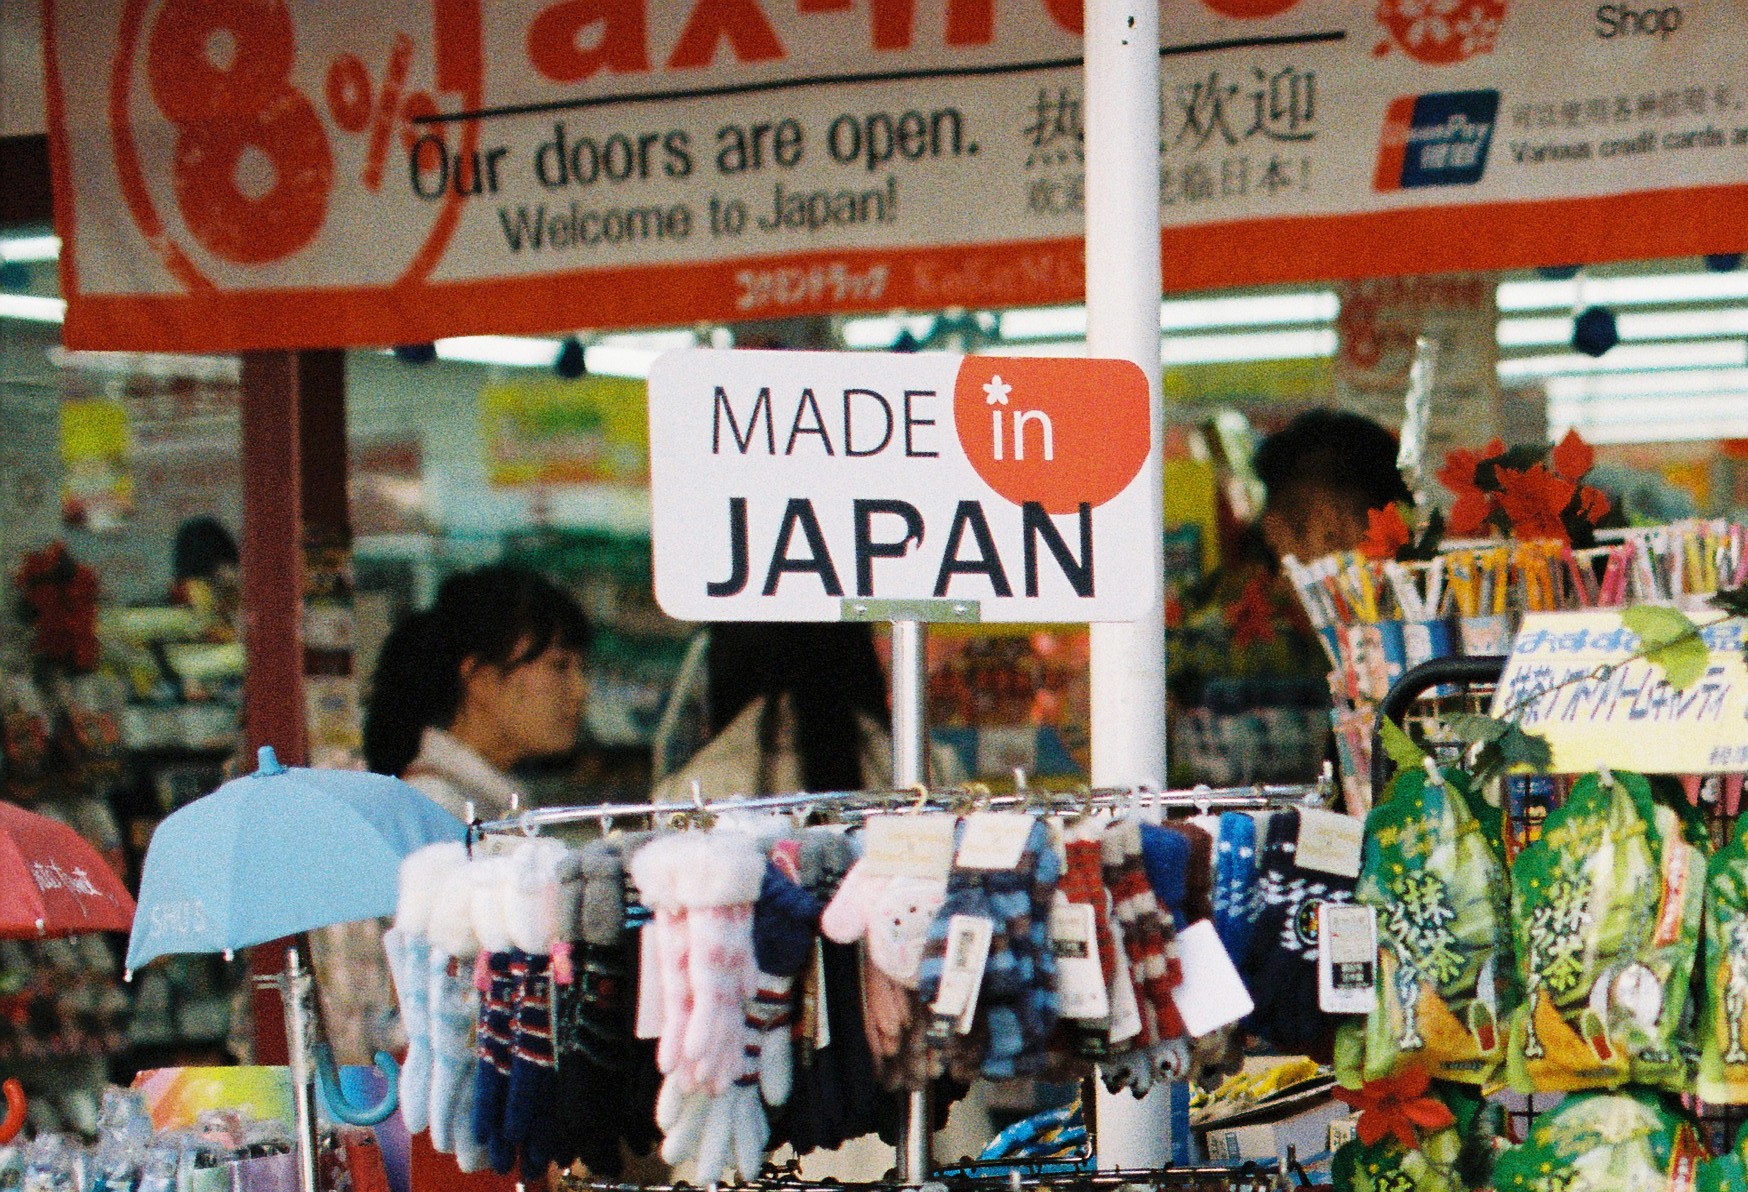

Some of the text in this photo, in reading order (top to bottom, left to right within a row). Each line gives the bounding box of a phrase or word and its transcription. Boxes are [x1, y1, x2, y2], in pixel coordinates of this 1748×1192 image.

[1597, 3, 1683, 41] Shop
[410, 106, 981, 200] Our doors are open.
[500, 175, 898, 253] Welcome to Japan!
[711, 375, 1054, 461] MADE in
[706, 497, 1096, 599] JAPAN
